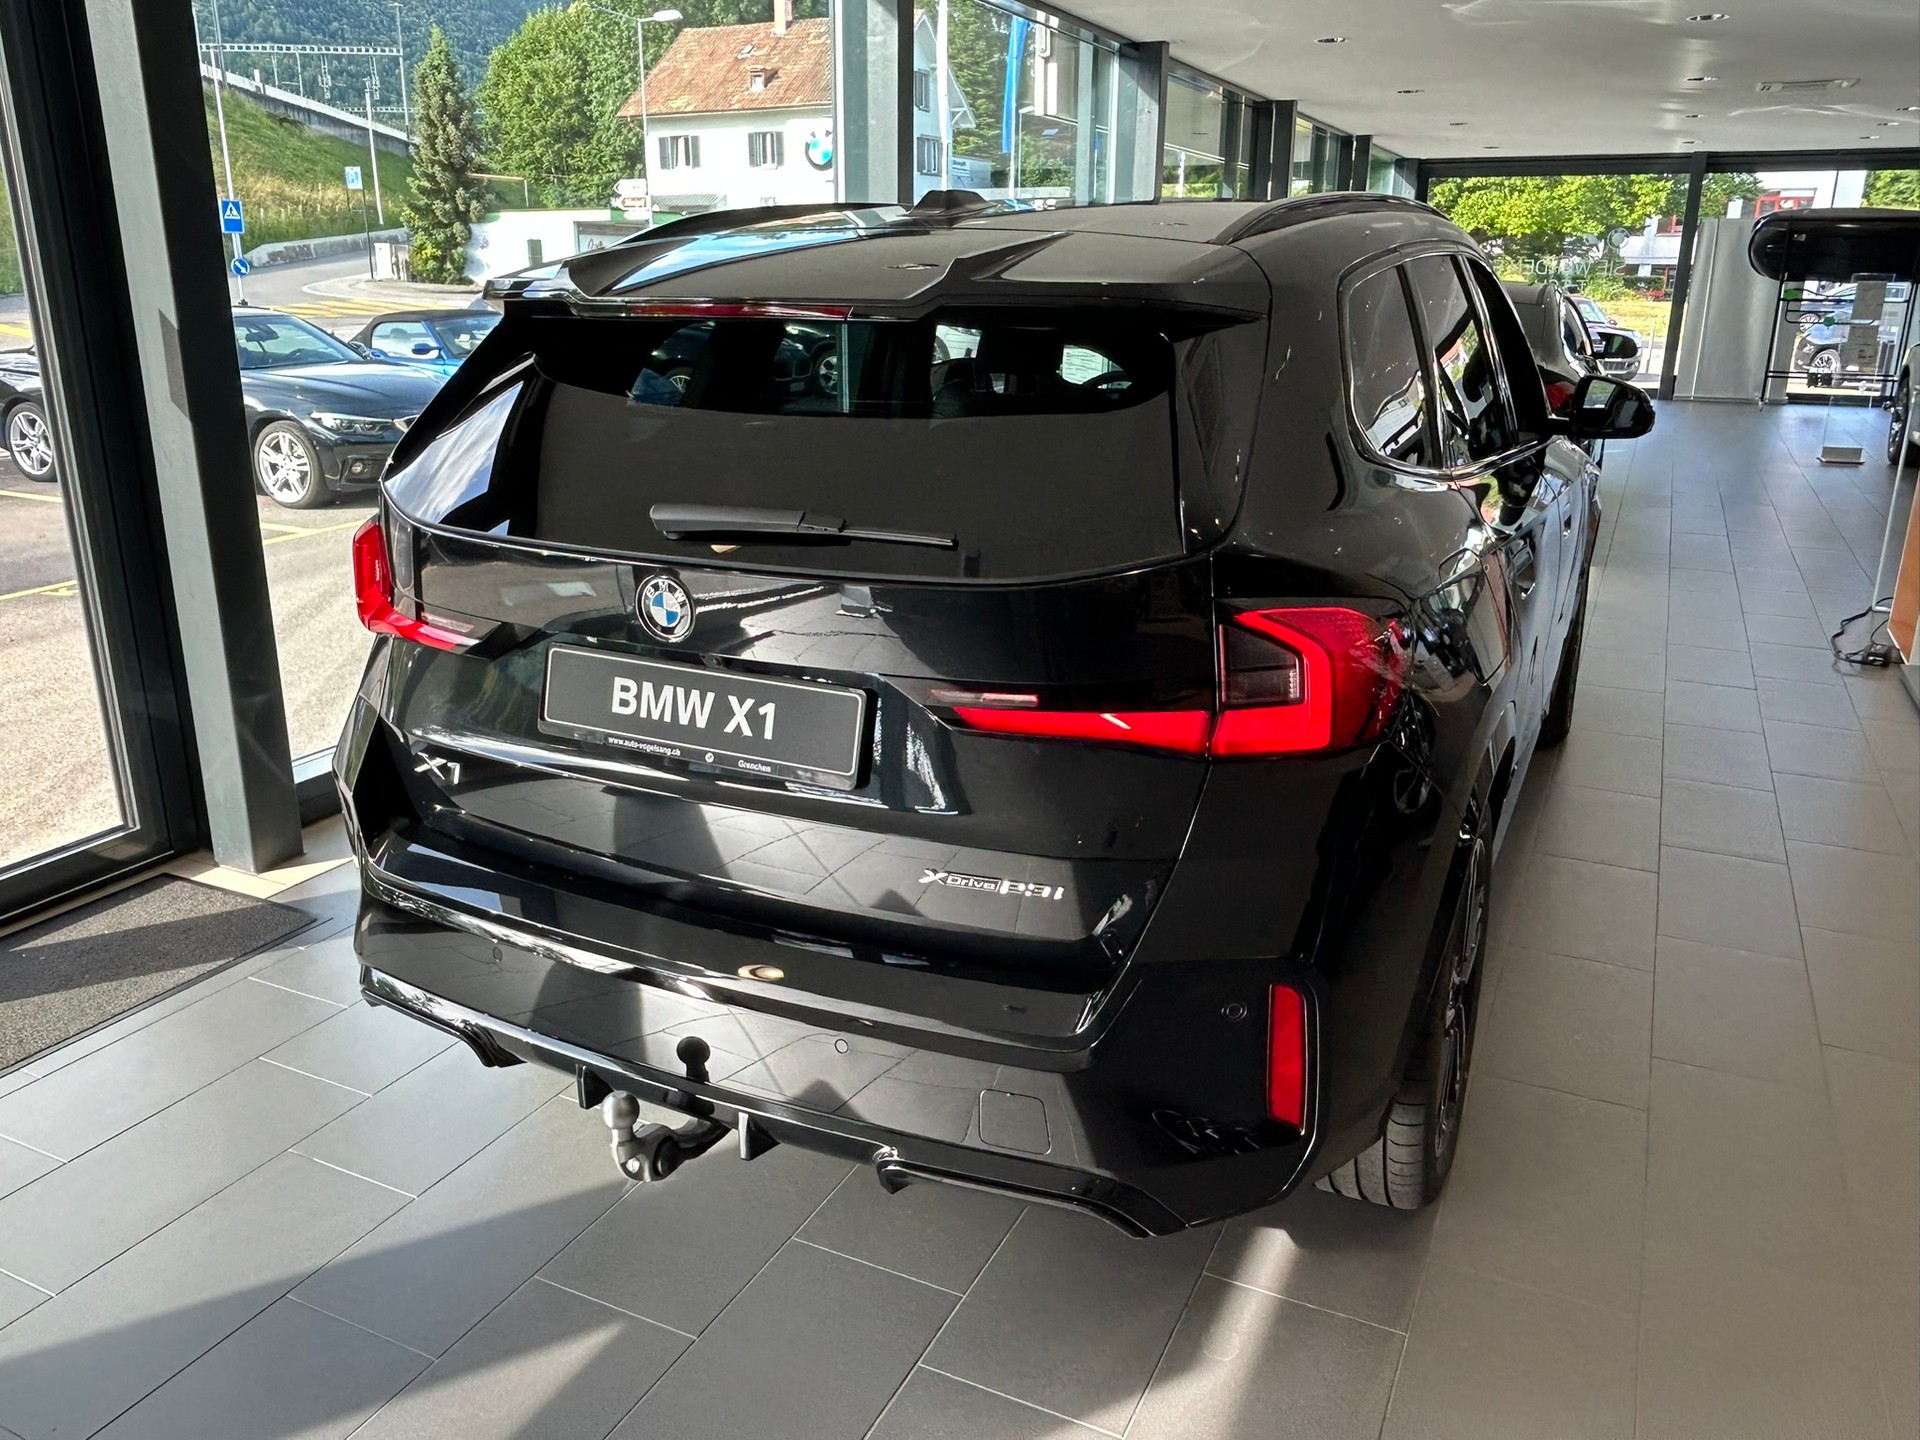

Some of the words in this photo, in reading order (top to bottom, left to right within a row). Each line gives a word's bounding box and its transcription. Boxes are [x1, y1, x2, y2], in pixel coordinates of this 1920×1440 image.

[611, 676, 716, 729] BMW
[723, 694, 777, 740] X1
[413, 751, 461, 785] X1
